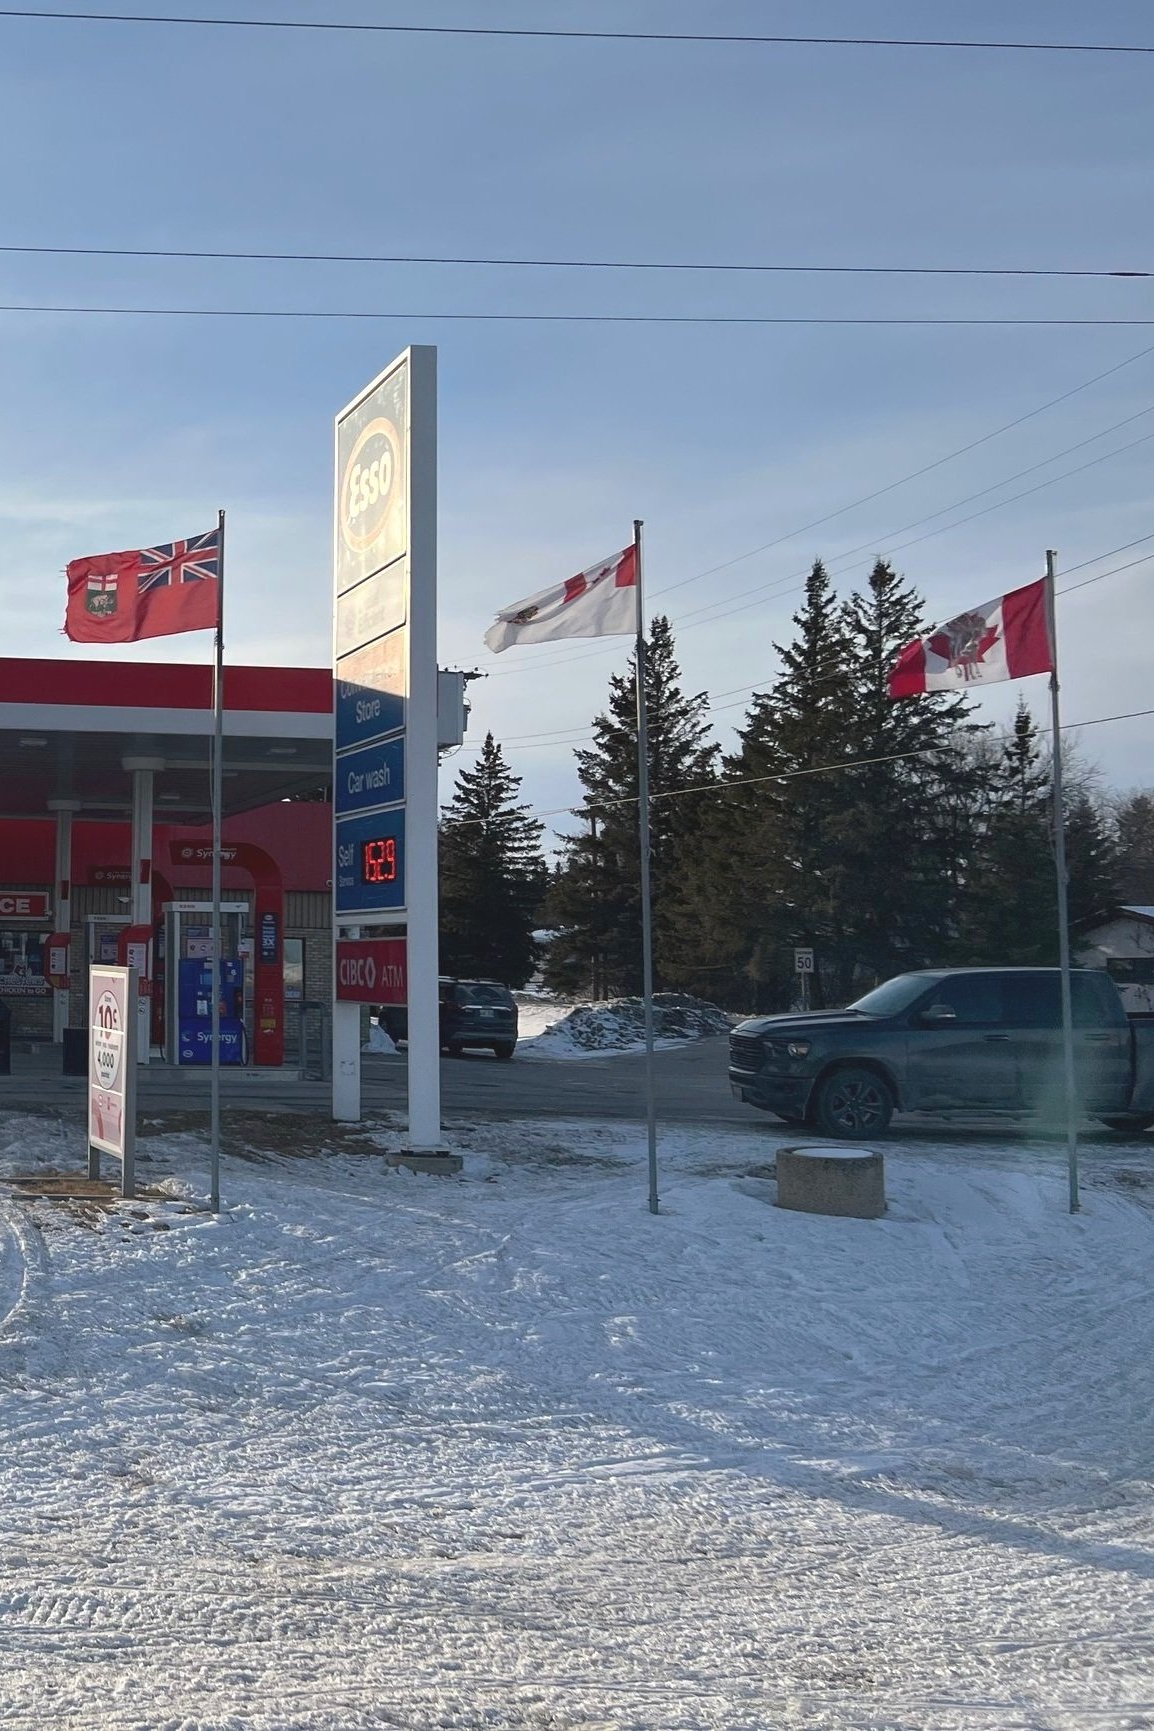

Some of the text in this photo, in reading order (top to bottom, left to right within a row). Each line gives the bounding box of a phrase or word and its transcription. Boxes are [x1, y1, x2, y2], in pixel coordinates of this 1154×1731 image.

[348, 451, 392, 518] Esso
[355, 699, 381, 724] Store
[347, 762, 391, 794] Car wash
[338, 843, 354, 868] Self
[340, 958, 404, 988] CIBC ATM
[797, 956, 811, 969] 50
[98, 1050, 115, 1069] 4,000
